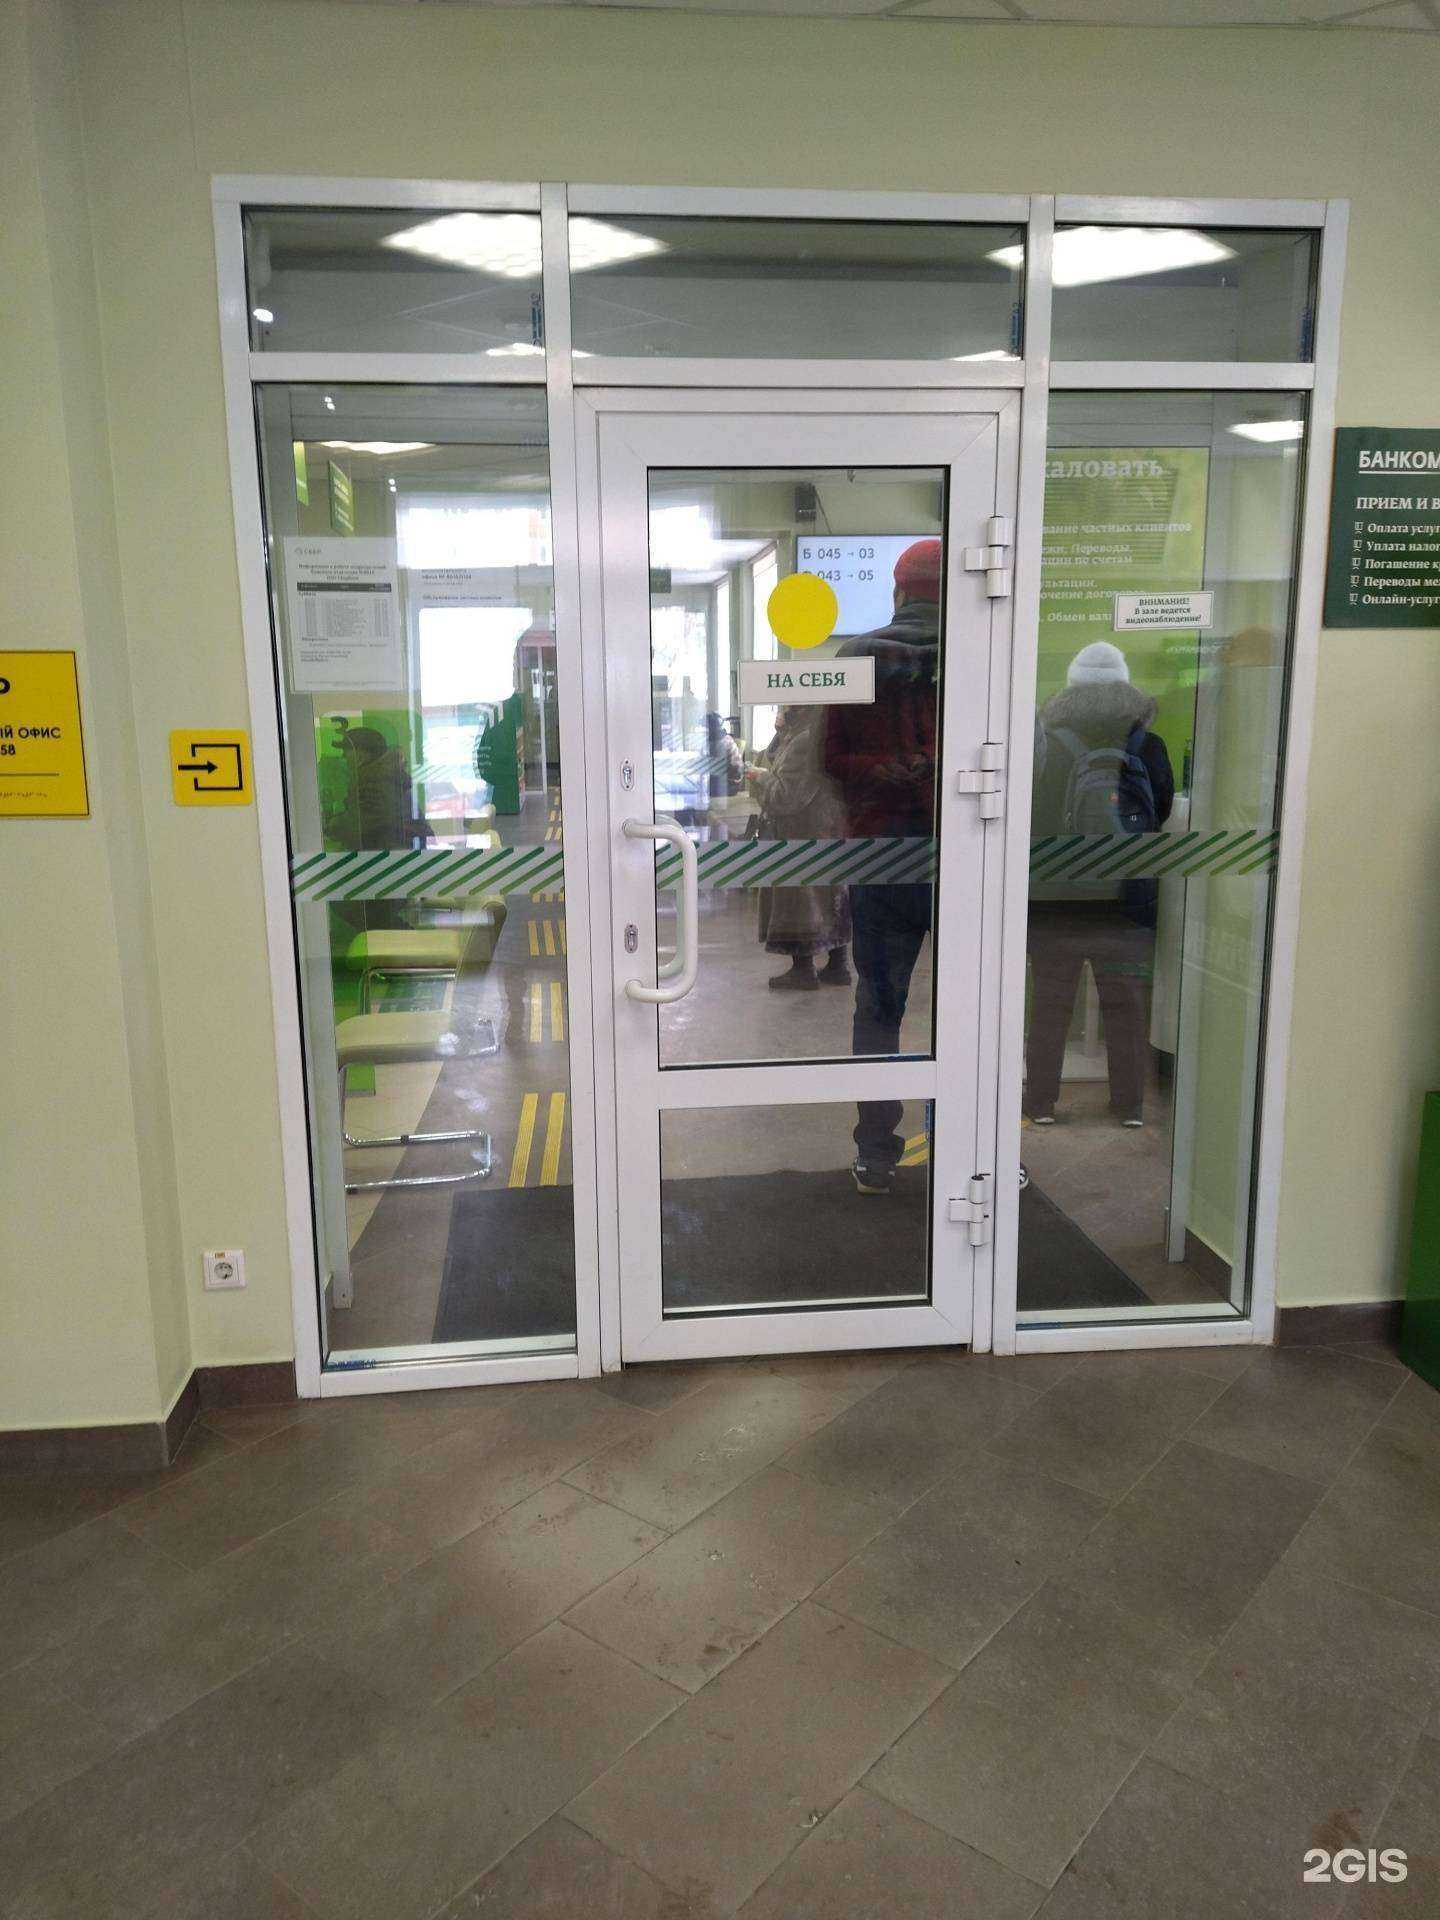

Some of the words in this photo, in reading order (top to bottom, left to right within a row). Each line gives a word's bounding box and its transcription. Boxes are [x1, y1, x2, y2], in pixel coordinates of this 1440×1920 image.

[1046, 459, 1163, 478] аловать
[1356, 496, 1412, 509] ПРИЕМ
[1416, 497, 1428, 509] И
[1367, 523, 1409, 533] Оплата
[1366, 541, 1406, 551] Уплата
[817, 548, 841, 559] 045
[858, 547, 874, 559] 03
[1365, 559, 1430, 569] Погашение
[858, 570, 874, 580] 05
[1364, 577, 1421, 589] Переводы
[767, 673, 794, 689] НА
[799, 672, 846, 687] СЕБЯ
[18, 726, 61, 739] ОФИС
